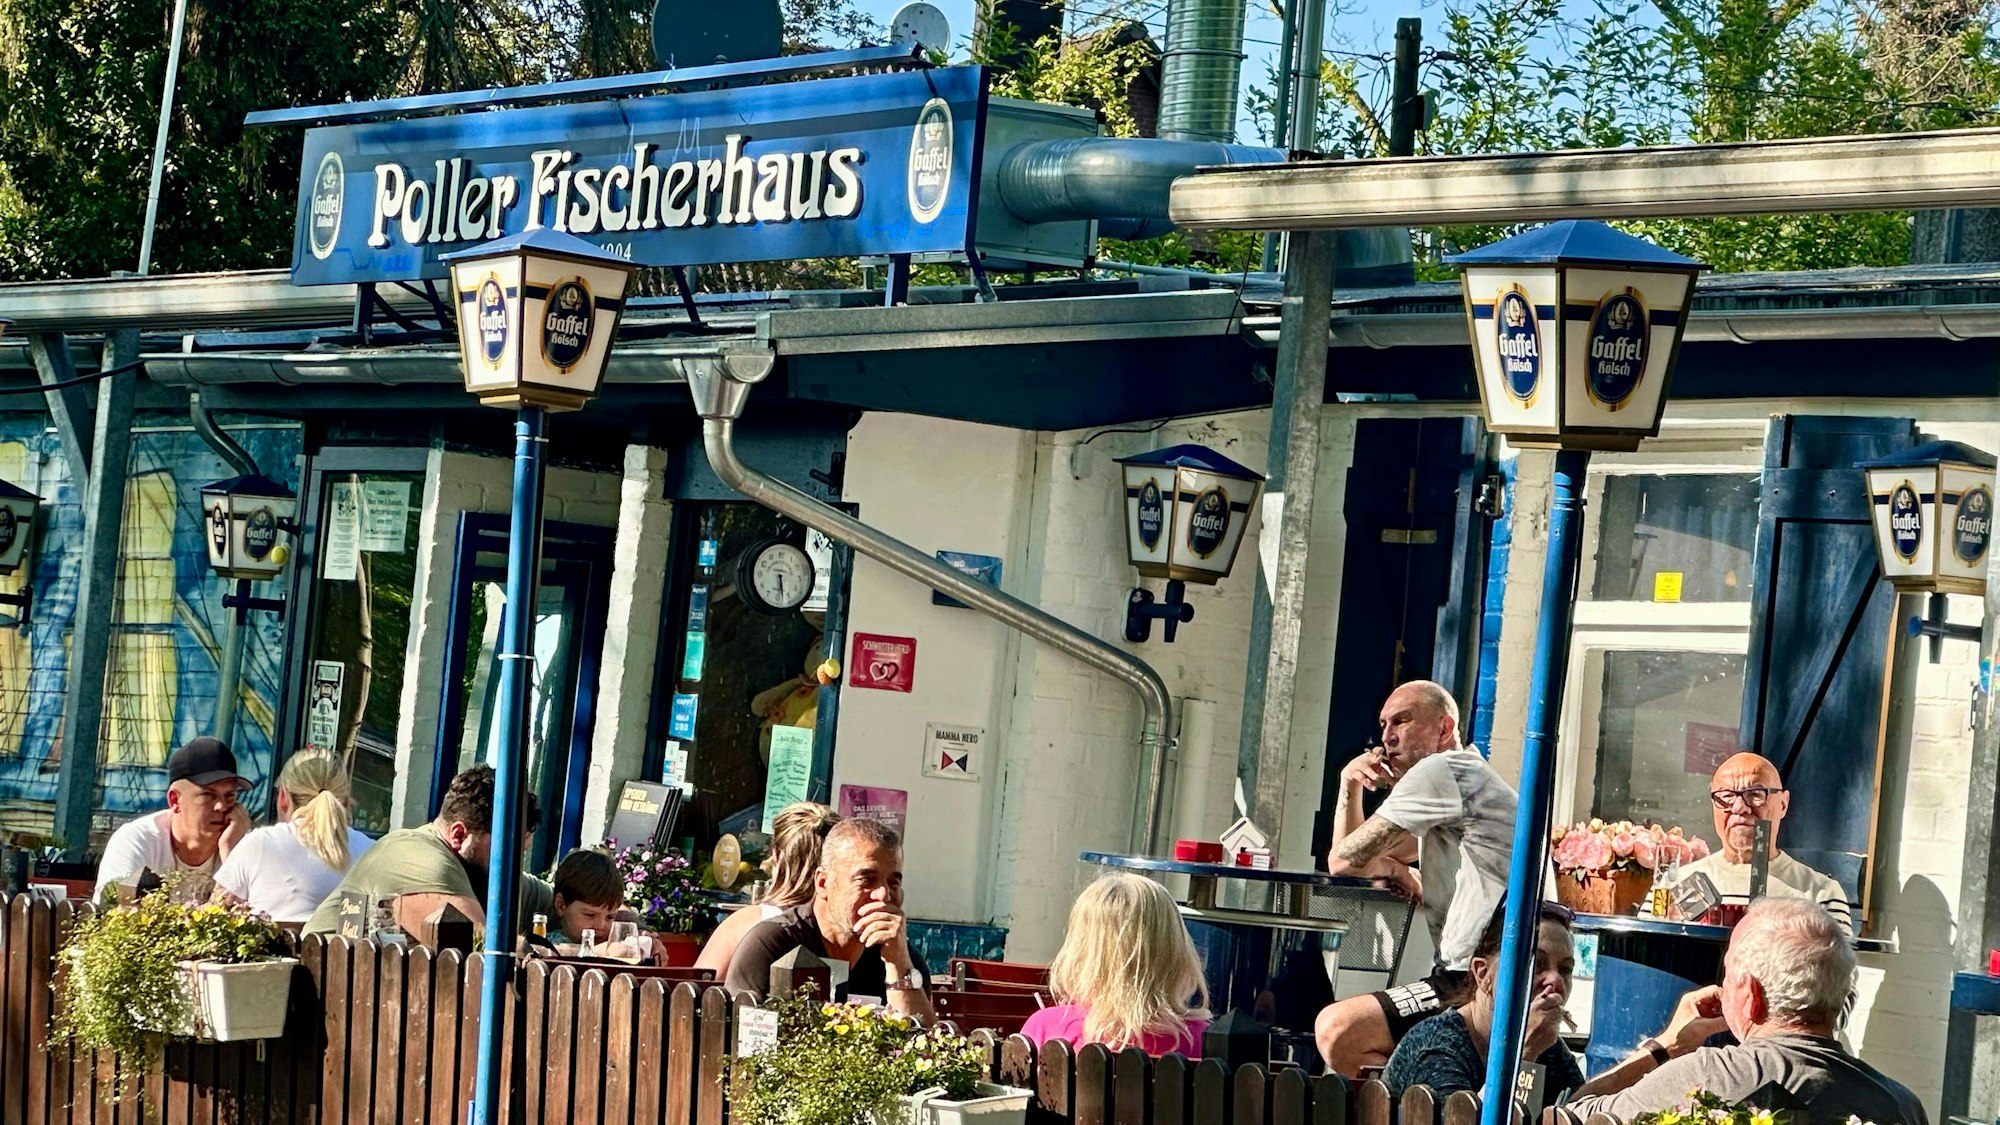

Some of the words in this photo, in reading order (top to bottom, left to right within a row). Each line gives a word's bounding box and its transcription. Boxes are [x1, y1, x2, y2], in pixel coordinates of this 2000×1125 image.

[914, 147, 948, 172] Gaffel
[367, 156, 516, 247] Poller
[524, 133, 862, 233] Fischerhaus
[315, 194, 340, 216] Gaffel
[480, 309, 507, 331] Gaffel
[546, 312, 589, 337] Gaffel
[551, 331, 579, 348] Kölsch
[1499, 331, 1539, 359] Gaffel
[1591, 335, 1642, 362] Gaffel
[1507, 357, 1533, 374] Kölsch
[1598, 359, 1631, 377] Kölsch
[1140, 506, 1161, 523] Gaffel
[1192, 512, 1225, 532] Gaffel
[1892, 512, 1921, 531] Gaffel
[246, 527, 274, 541] Gaffel
[1957, 515, 1991, 535] Gaffel
[935, 729, 960, 742] MAMMA
[961, 733, 979, 744] NERO
